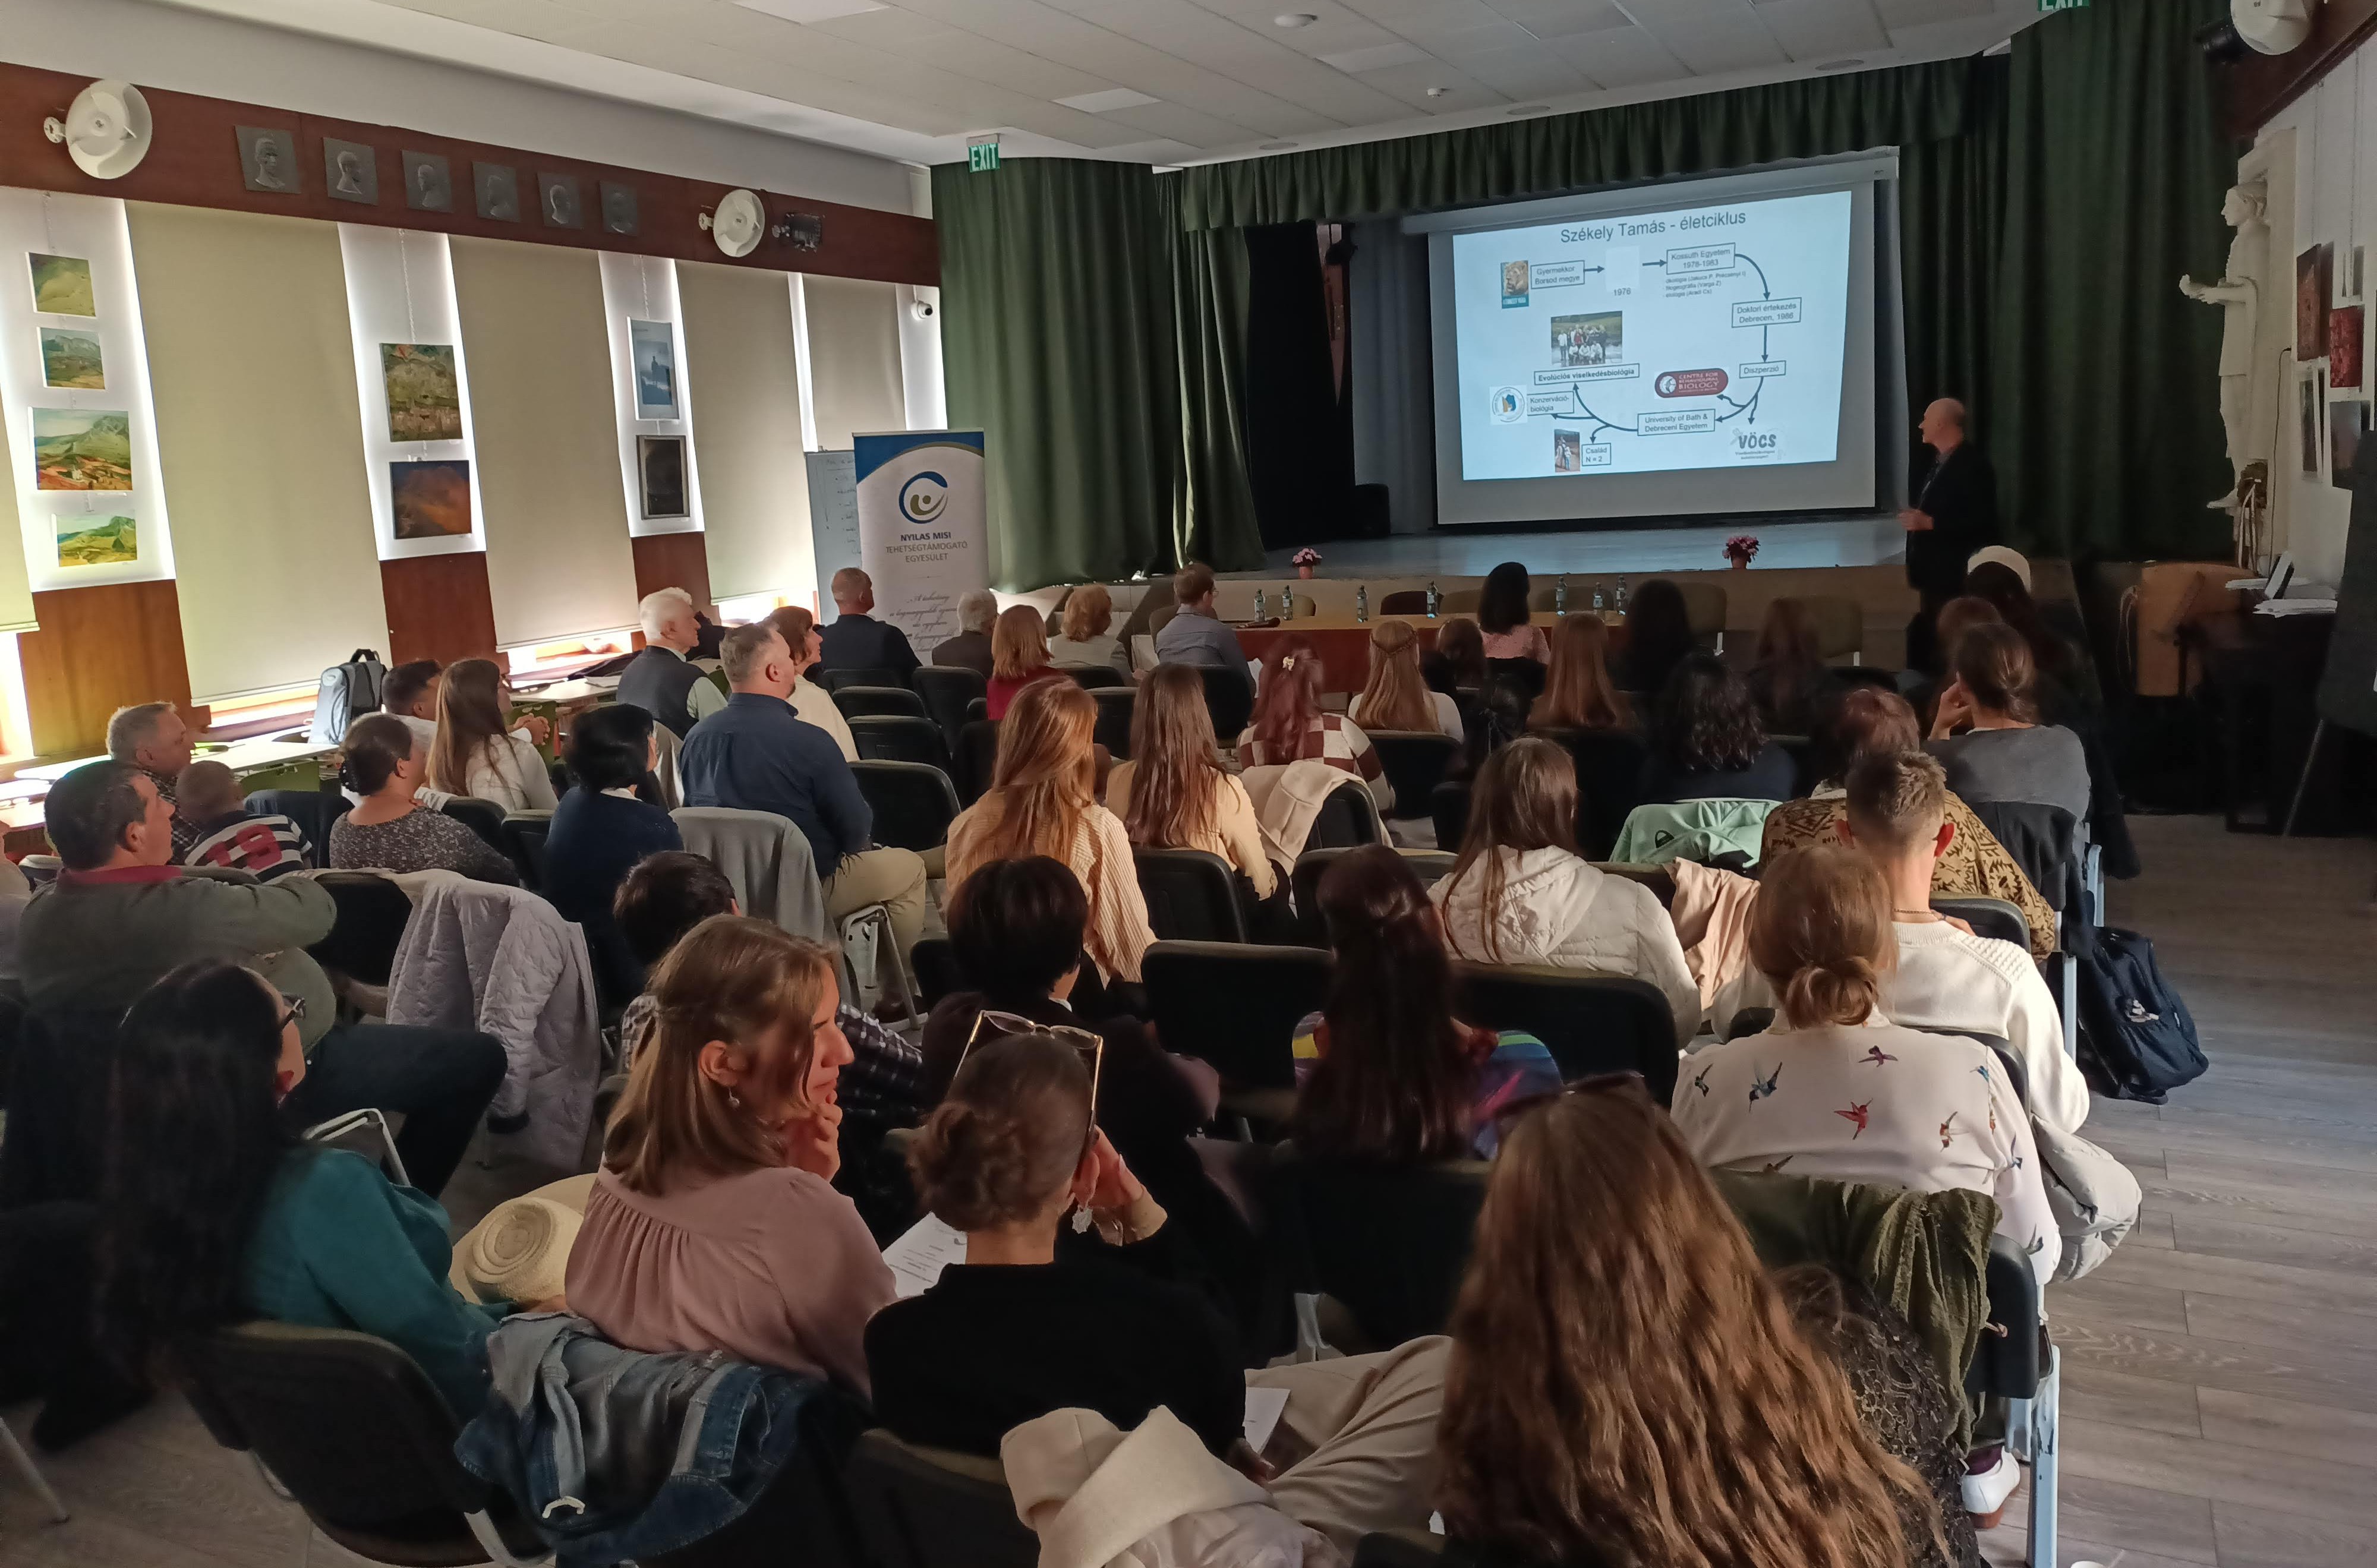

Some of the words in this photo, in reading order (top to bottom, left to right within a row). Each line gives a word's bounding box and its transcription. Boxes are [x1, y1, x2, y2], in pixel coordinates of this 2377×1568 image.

[970, 143, 997, 172] EXIT
[1561, 225, 1614, 243] Székely
[1618, 220, 1666, 236] Tamás
[1680, 212, 1747, 231] életciklus
[1671, 252, 1698, 260] Kossuth
[1700, 249, 1730, 258] Egyetem
[1536, 266, 1575, 276] Gyermekkor
[1559, 275, 1580, 283] megye
[1614, 288, 1631, 296] 1976
[1737, 305, 1761, 314] Doktori
[1763, 303, 1797, 312] értekezés
[1539, 373, 1571, 381] Evolúciós
[1572, 368, 1635, 378] viselkedésbiológia
[1744, 365, 1779, 375] Diszperzió
[1679, 381, 1720, 390] BIOLOGY
[1530, 395, 1569, 404] Konzerváció-
[1645, 424, 1678, 433] Debreceni
[1739, 432, 1777, 449] VÖCS
[900, 532, 931, 541] NYILAS
[932, 531, 951, 540] MISI
